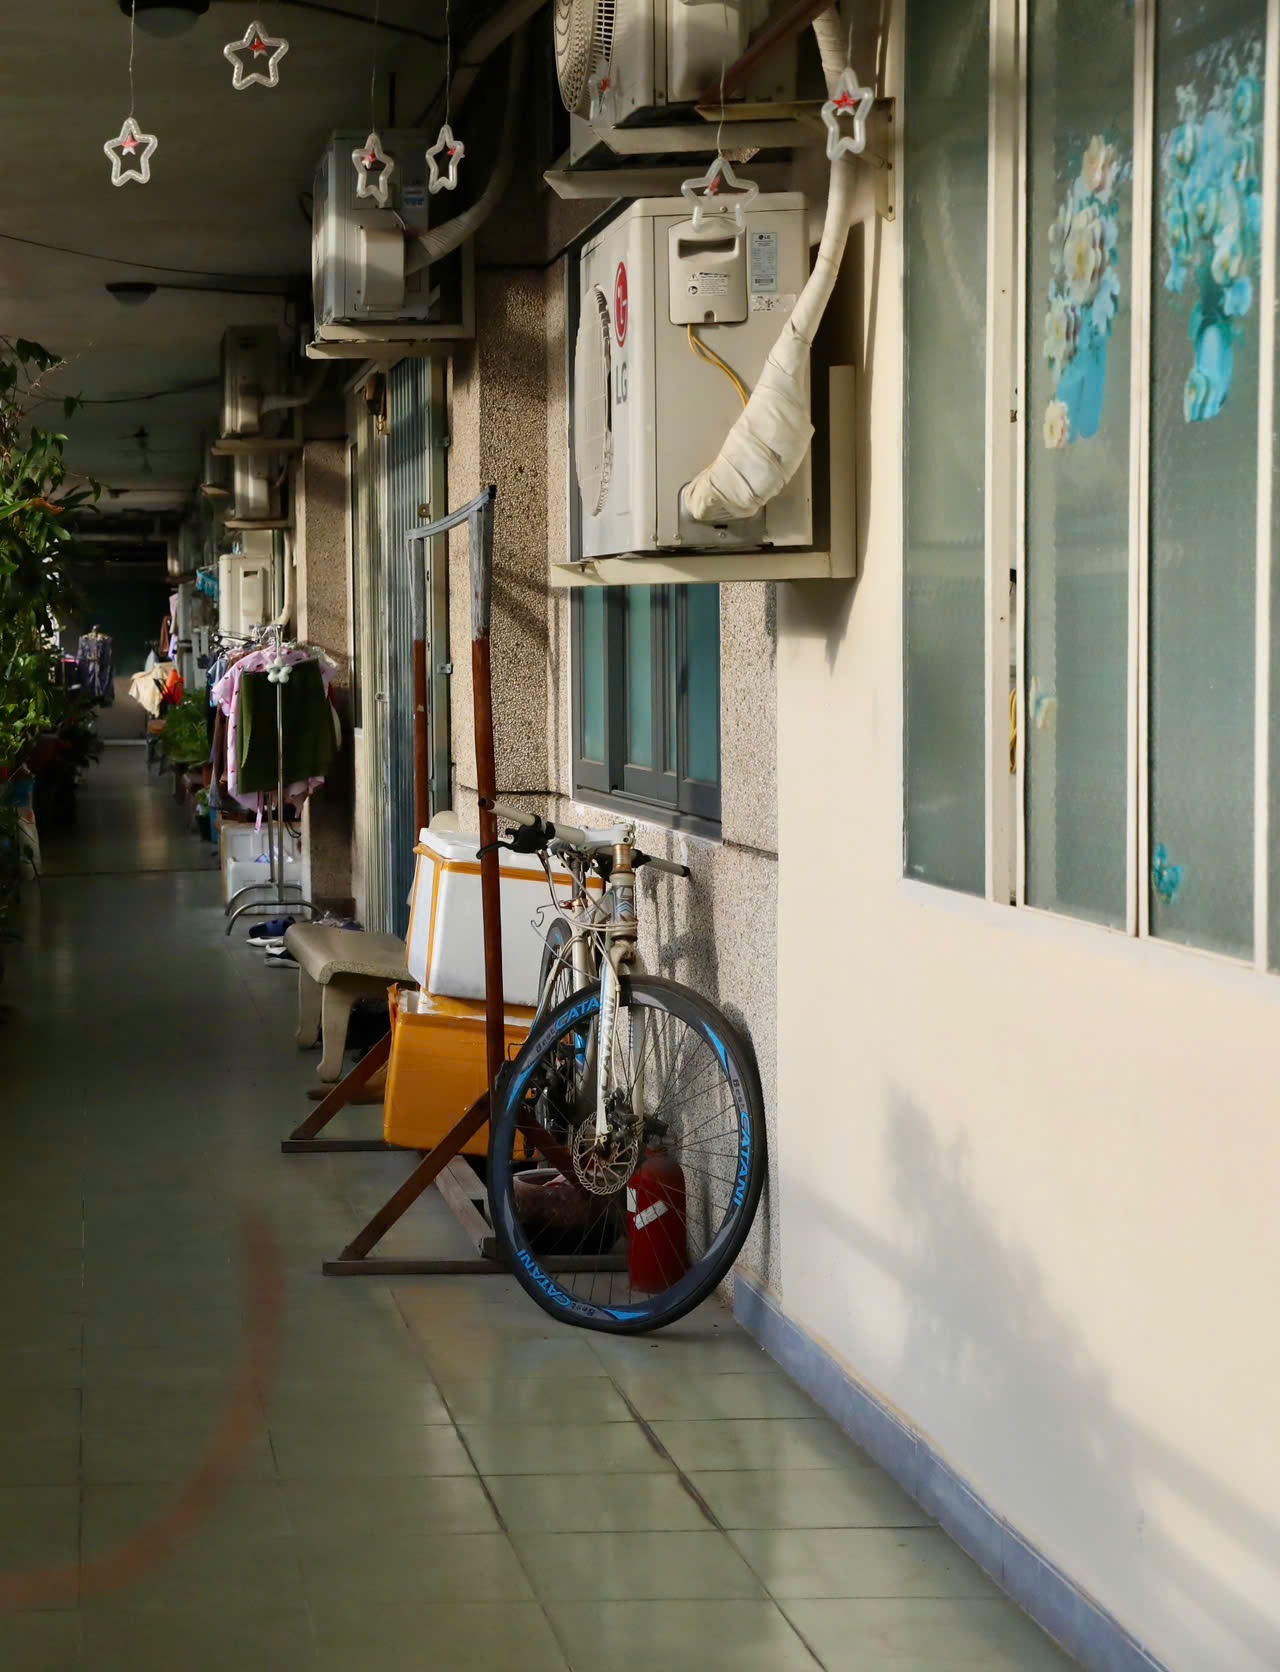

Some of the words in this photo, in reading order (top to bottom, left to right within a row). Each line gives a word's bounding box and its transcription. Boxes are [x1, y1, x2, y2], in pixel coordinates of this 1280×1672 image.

[616, 361, 628, 405] LG
[555, 996, 600, 1031] CATA
[733, 1111, 751, 1206] CATANI
[517, 1249, 571, 1307] CATANI
